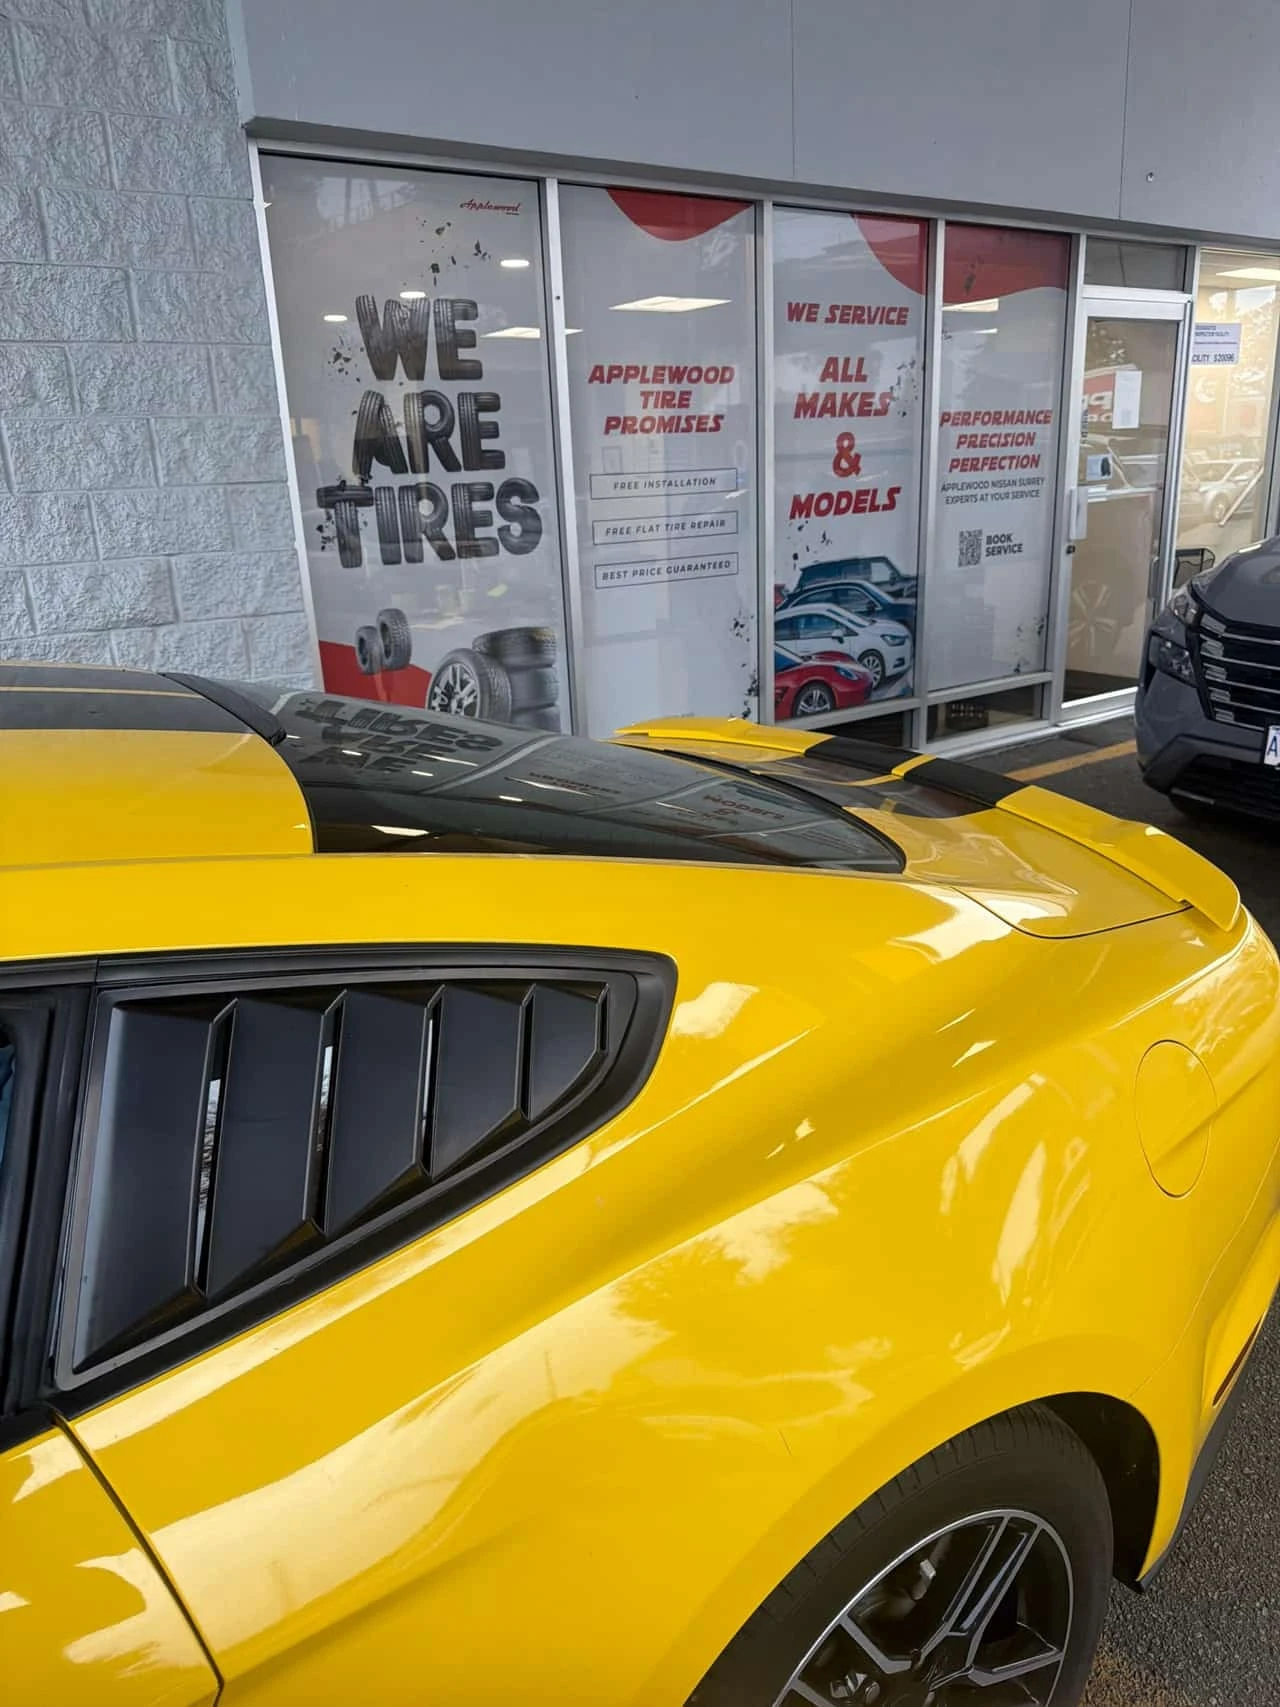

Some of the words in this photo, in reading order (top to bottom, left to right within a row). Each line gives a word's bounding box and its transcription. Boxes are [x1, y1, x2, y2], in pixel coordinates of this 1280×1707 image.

[460, 199, 521, 213] Applewood
[787, 302, 820, 323] WE
[824, 304, 909, 325] SERVICE
[355, 295, 483, 381] WE
[588, 364, 735, 385] APPLEWOOD
[819, 356, 867, 383] ALL
[640, 390, 693, 409] TIRE
[793, 391, 893, 419] MAKES
[603, 414, 724, 435] PROMISES
[939, 409, 1053, 427] PERFORMANCE
[351, 389, 505, 474] ARE
[956, 432, 1036, 449] PRECISION
[832, 431, 862, 478] &
[949, 454, 1040, 473] PERFECTION
[613, 481, 639, 491] FREE
[643, 477, 717, 489] INSTALLATION
[941, 480, 989, 493] APPLEWOOD
[991, 478, 1017, 489] NISSAN
[1018, 477, 1045, 487] SURREY
[789, 486, 901, 520] MODELS
[945, 493, 978, 505] EXPERTS
[979, 492, 989, 502] AT
[990, 491, 1010, 501] YOUR
[1011, 489, 1040, 499] SERVICE
[316, 477, 543, 569] TIRES
[605, 526, 631, 536] FREE
[635, 524, 660, 534] FLAT
[664, 522, 686, 532] TIRE
[690, 519, 726, 530] REPAIR
[986, 533, 1013, 546] BOOK
[985, 543, 1023, 557] SERVICE
[601, 570, 628, 581] BEST
[632, 566, 662, 578] PRICE
[666, 560, 731, 575] GUARANTEED
